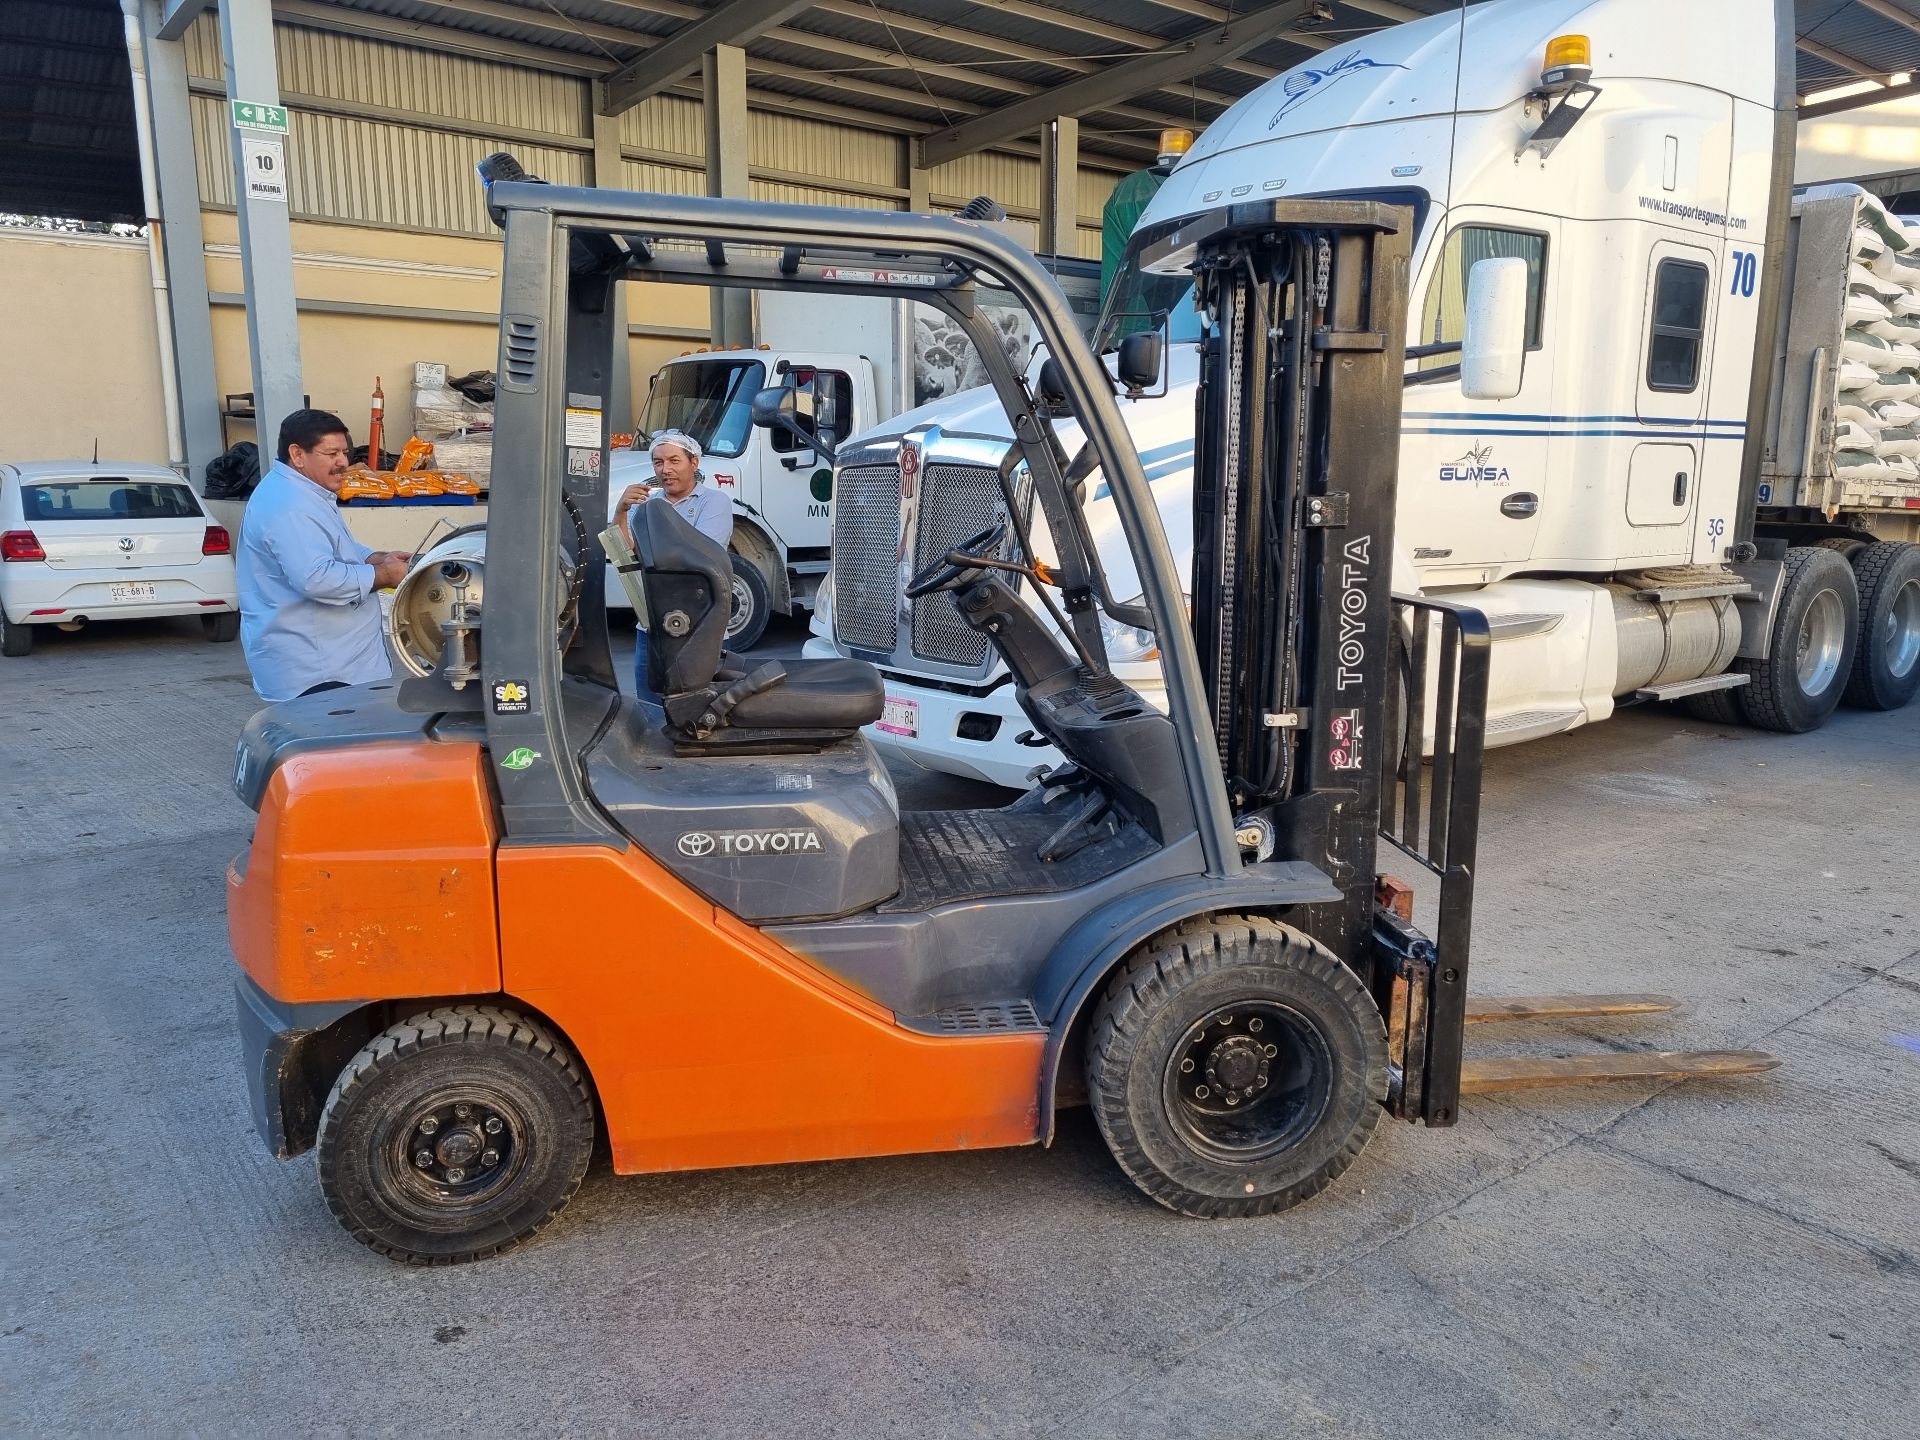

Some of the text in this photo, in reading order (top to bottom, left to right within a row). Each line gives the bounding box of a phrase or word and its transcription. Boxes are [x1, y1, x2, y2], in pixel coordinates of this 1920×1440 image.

[255, 155, 273, 170] 10
[1638, 196, 1747, 229] www.transportesgumsa.com
[1730, 250, 1757, 298] 70
[1439, 467, 1510, 481] GUMSA
[1707, 518, 1724, 536] 3G
[111, 586, 155, 597] SCE-681-B
[1337, 535, 1371, 690] TOYOTA
[495, 682, 527, 702] SAS
[719, 832, 821, 853] TOYOTA
